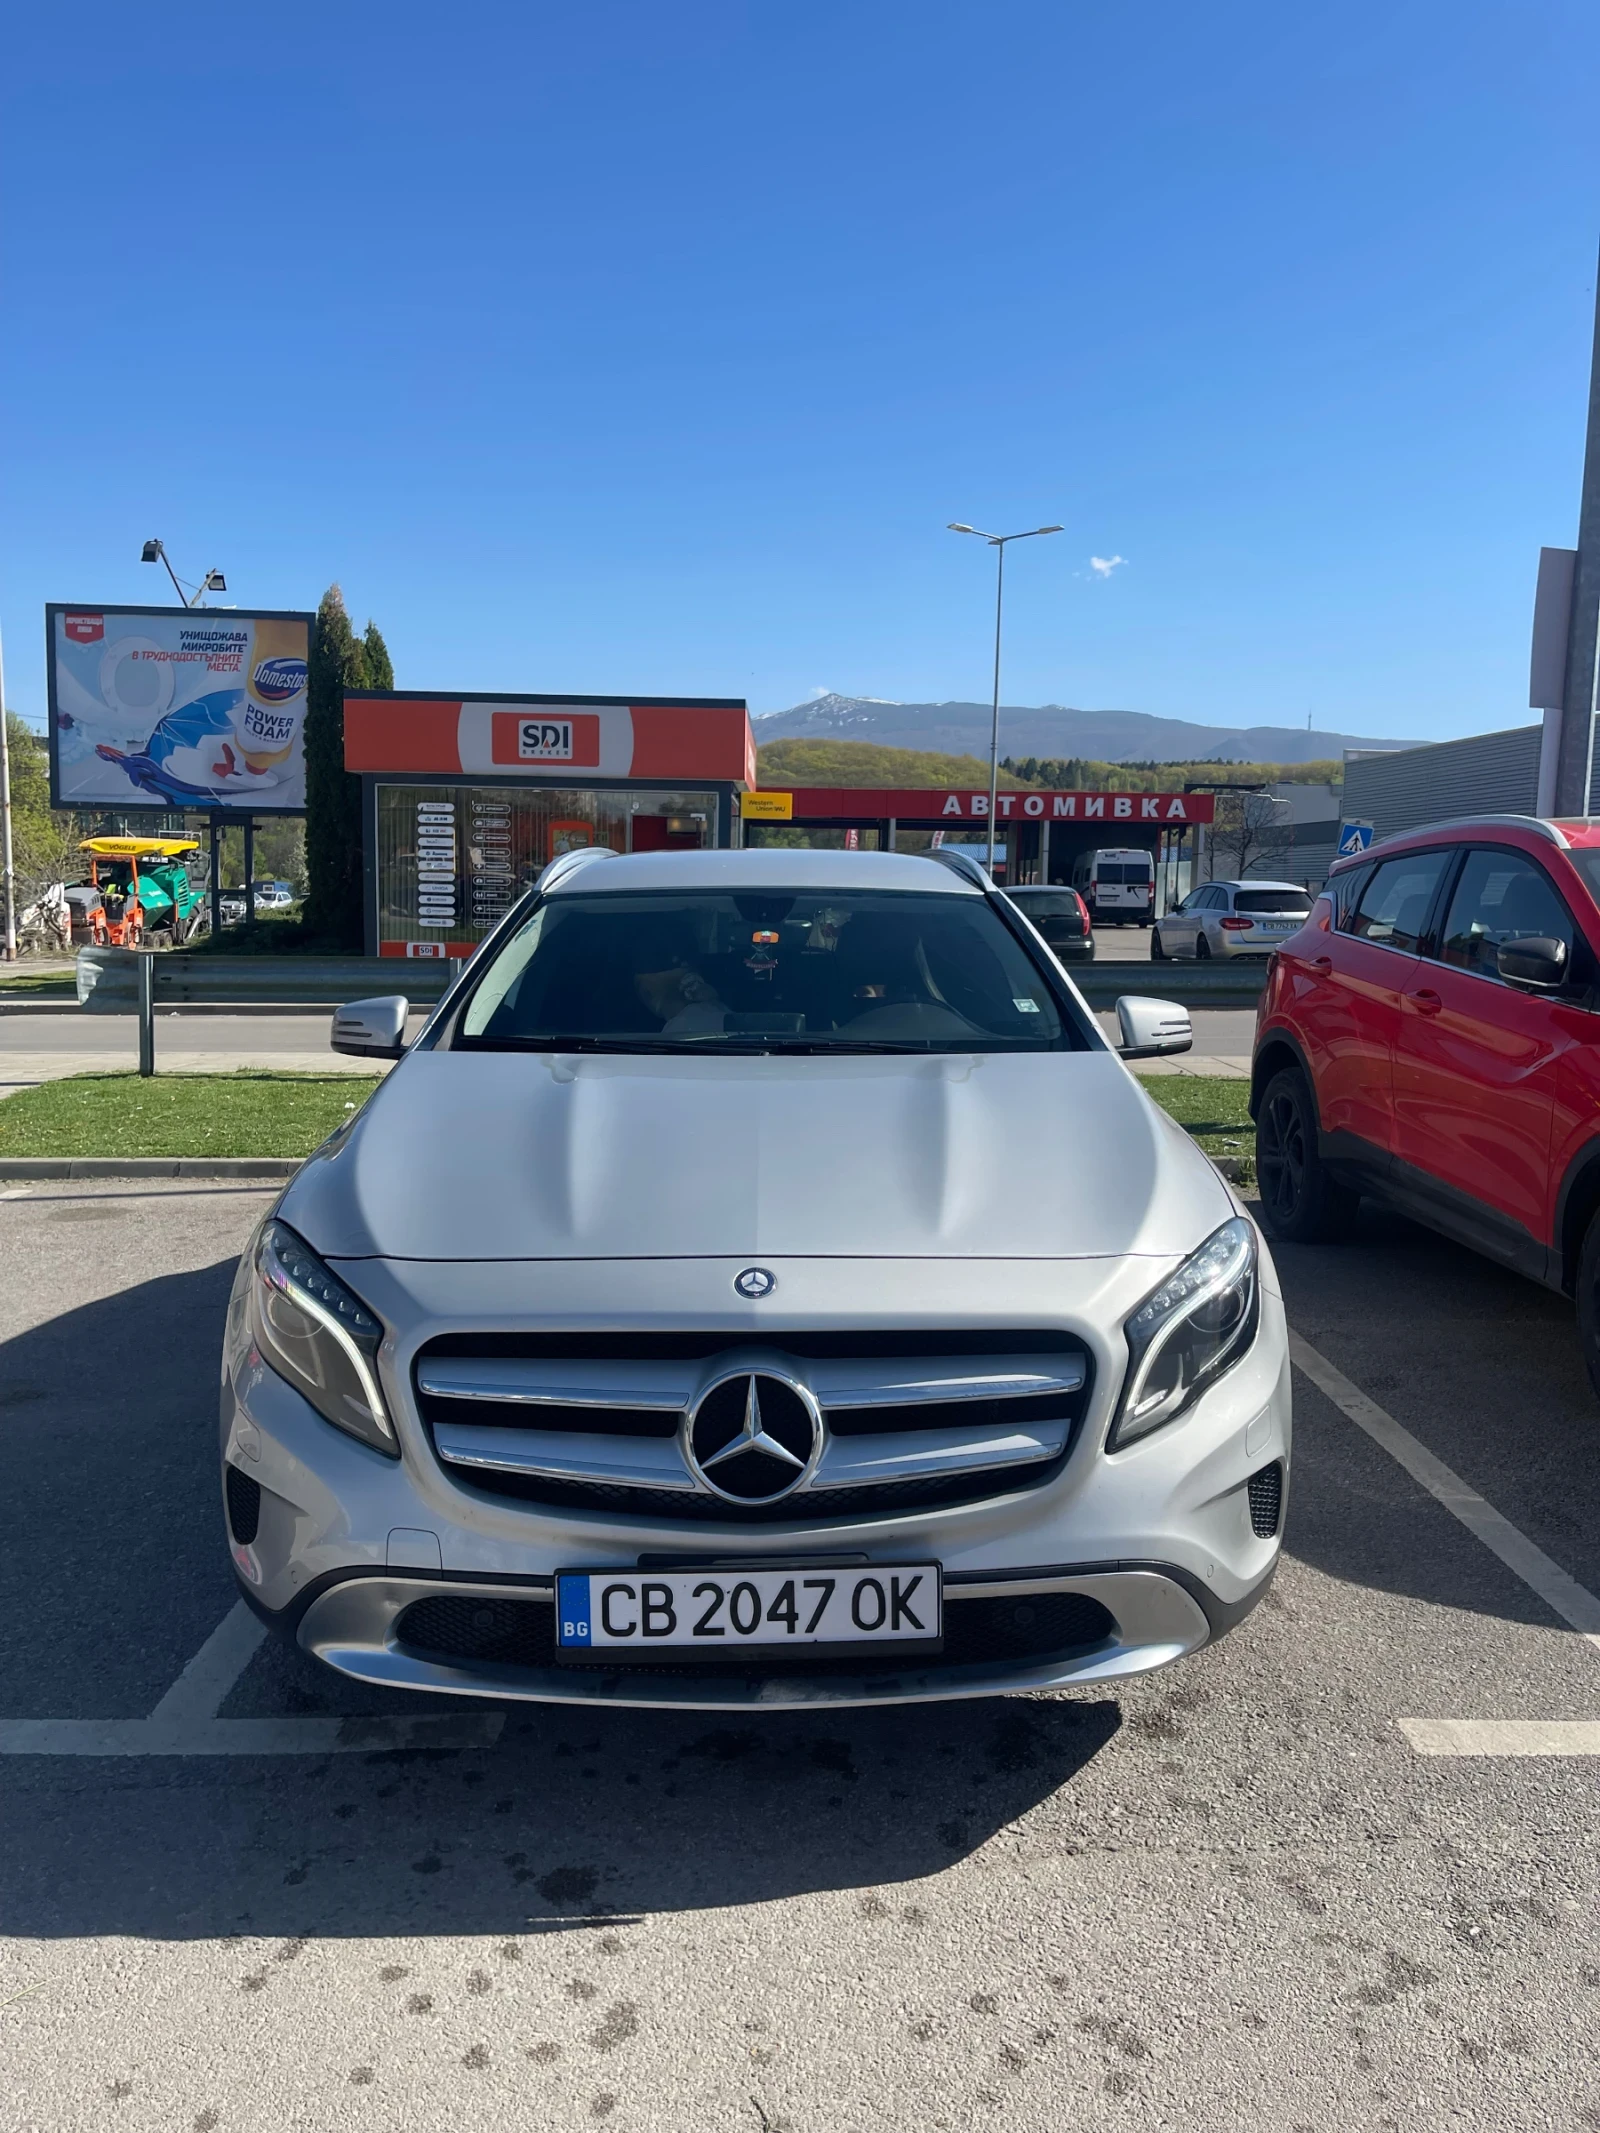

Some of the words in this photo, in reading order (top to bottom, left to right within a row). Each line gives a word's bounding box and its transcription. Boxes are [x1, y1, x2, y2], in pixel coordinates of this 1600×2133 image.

[180, 631, 248, 642] УНИЩОЖАВА
[132, 651, 139, 660] В
[142, 651, 243, 663] ТРУДНОДОСТЪПНИТЕ
[207, 663, 241, 672] МЕСТА.
[253, 662, 309, 689] Domestos
[245, 713, 290, 740] FOAM
[247, 703, 294, 728] POWER
[523, 724, 569, 748] SDI
[942, 795, 1187, 818] АВТОМИВКА
[601, 1583, 677, 1638] CB
[692, 1578, 836, 1636] 2047
[851, 1575, 926, 1632] OK
[564, 1622, 589, 1637] BG
